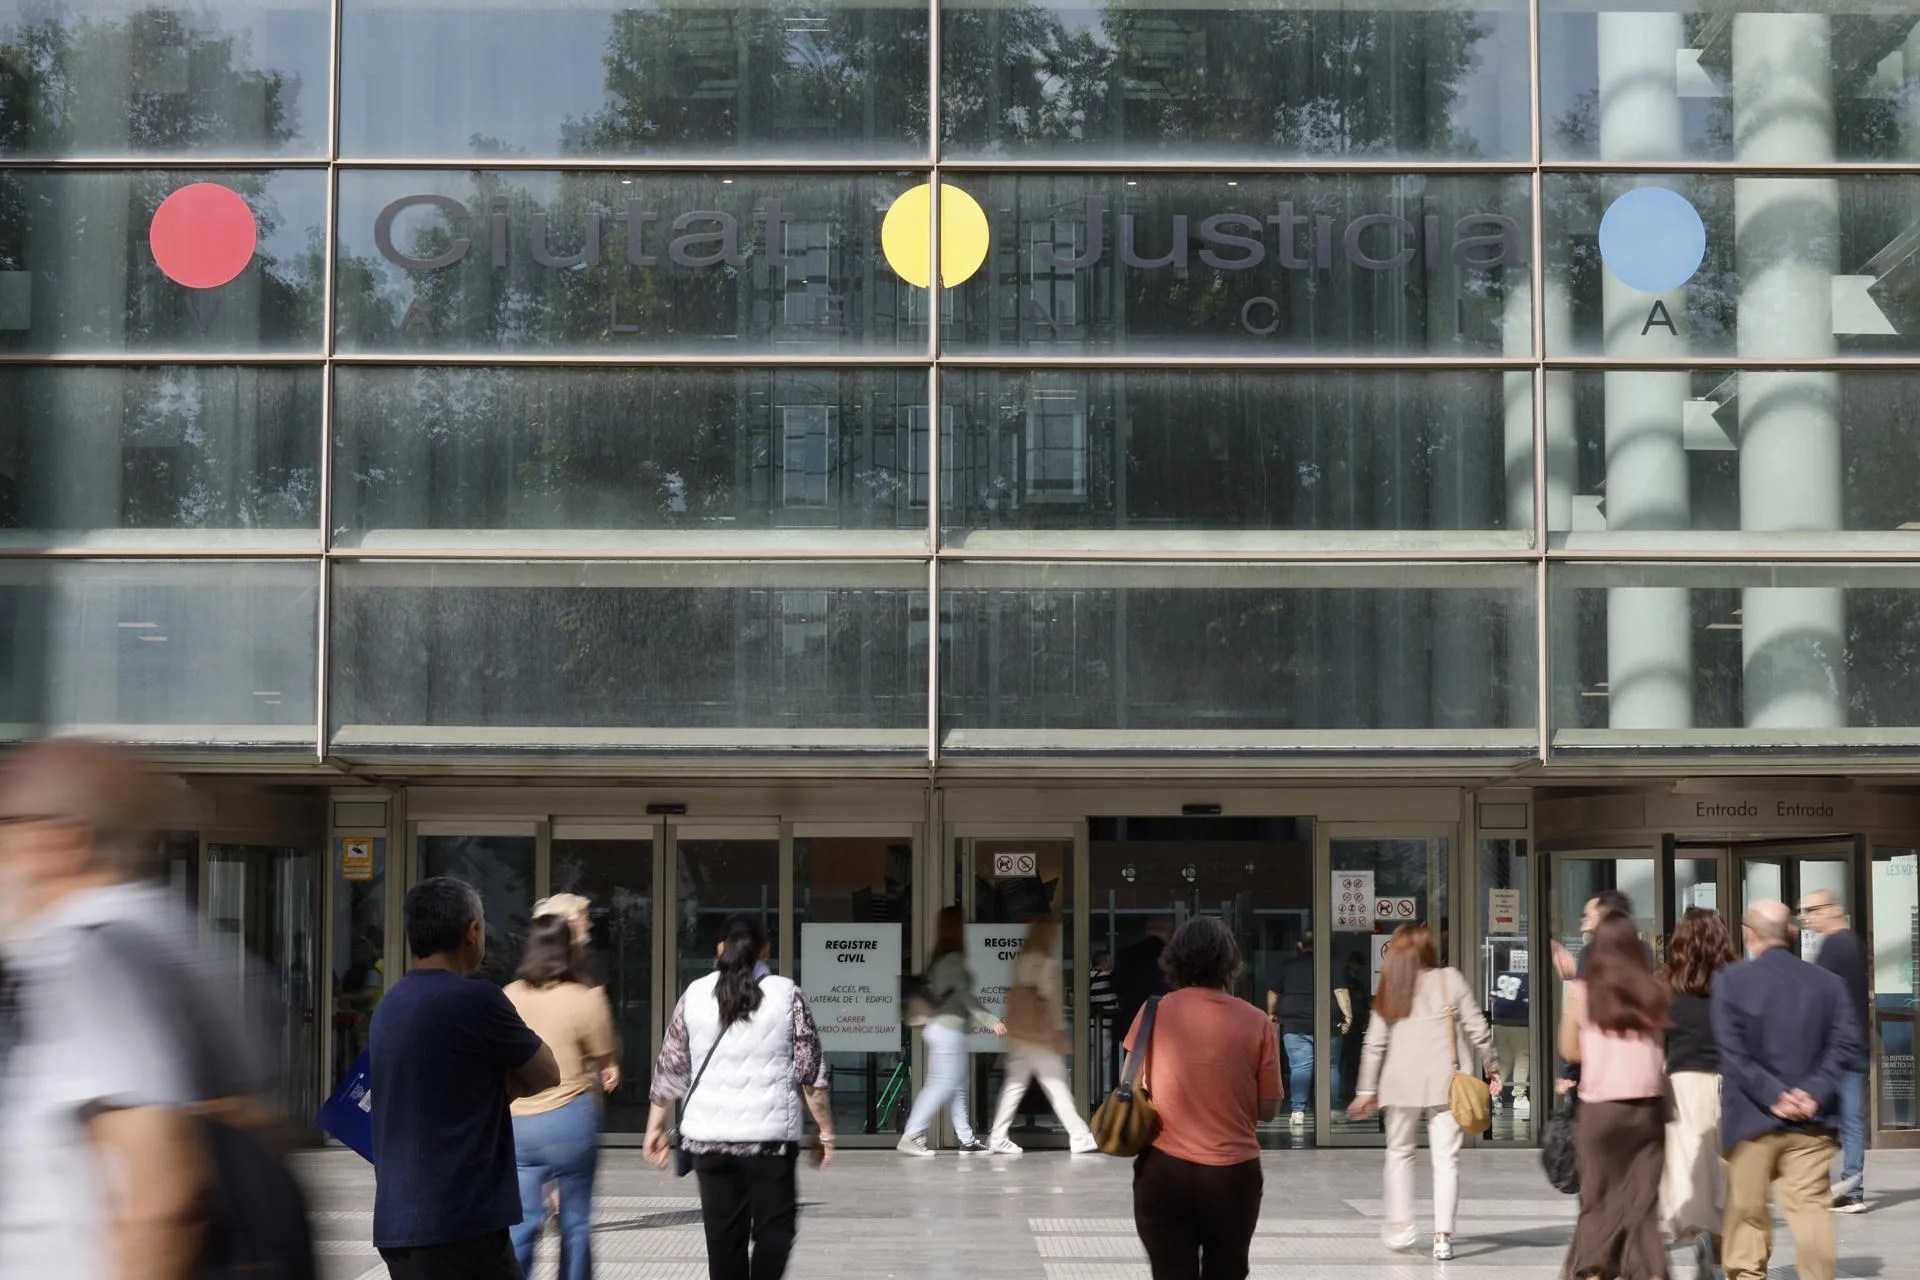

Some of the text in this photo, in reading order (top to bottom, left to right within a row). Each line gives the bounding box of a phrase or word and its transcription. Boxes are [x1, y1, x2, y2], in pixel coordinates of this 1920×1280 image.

[373, 193, 794, 269] Ciutat
[1696, 800, 1835, 817] Entrada Entrada
[825, 940, 878, 950] REGISTRE
[984, 938, 1025, 948] REGIST
[837, 953, 866, 963] CIVIL
[858, 985, 871, 993] PEL
[810, 995, 840, 1003] LATERAL
[843, 995, 853, 1003] DE
[865, 995, 893, 1003] EDIFICI
[836, 1015, 866, 1023] CARRER
[875, 1025, 896, 1034] SUAY
